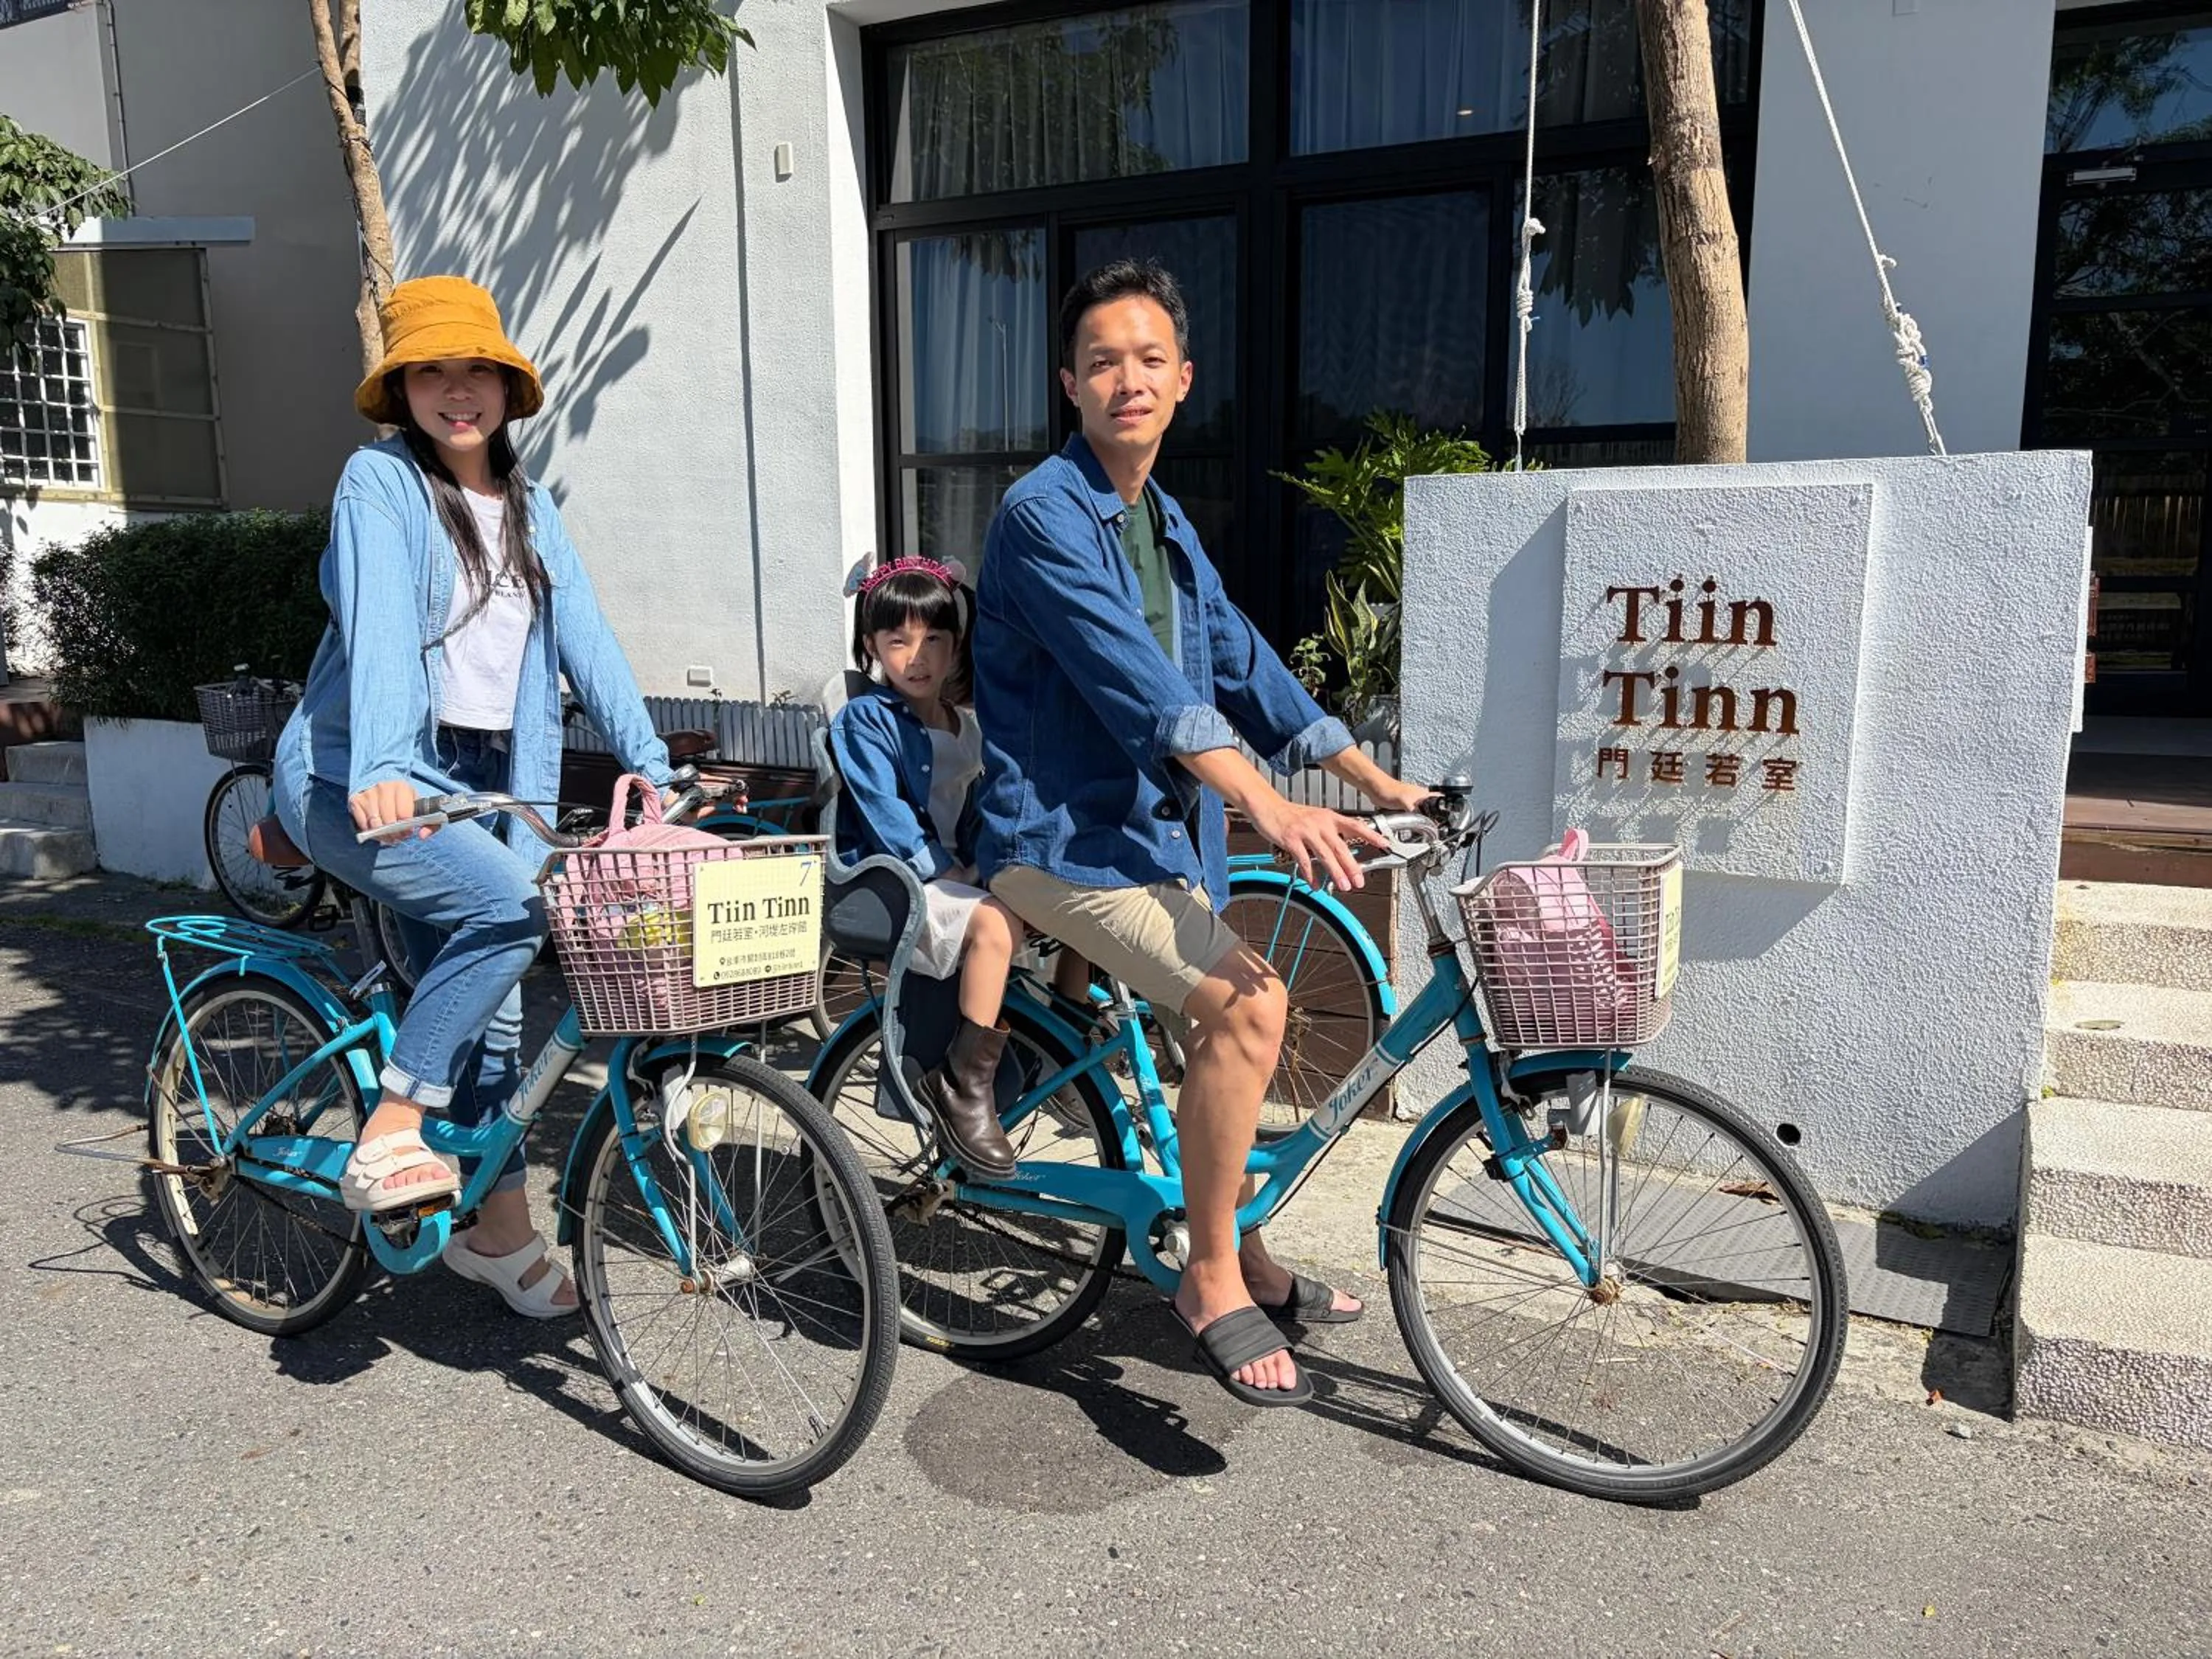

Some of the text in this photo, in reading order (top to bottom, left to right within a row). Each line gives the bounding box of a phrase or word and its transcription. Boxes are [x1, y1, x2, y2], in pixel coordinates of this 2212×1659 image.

[1606, 578, 1777, 646] Tiin
[1602, 666, 1800, 735] Tinn
[1596, 747, 1798, 791] 門廷若室
[800, 860, 812, 886] 7
[707, 896, 810, 925] Tiin Tinn
[1325, 1066, 1374, 1131] Joker
